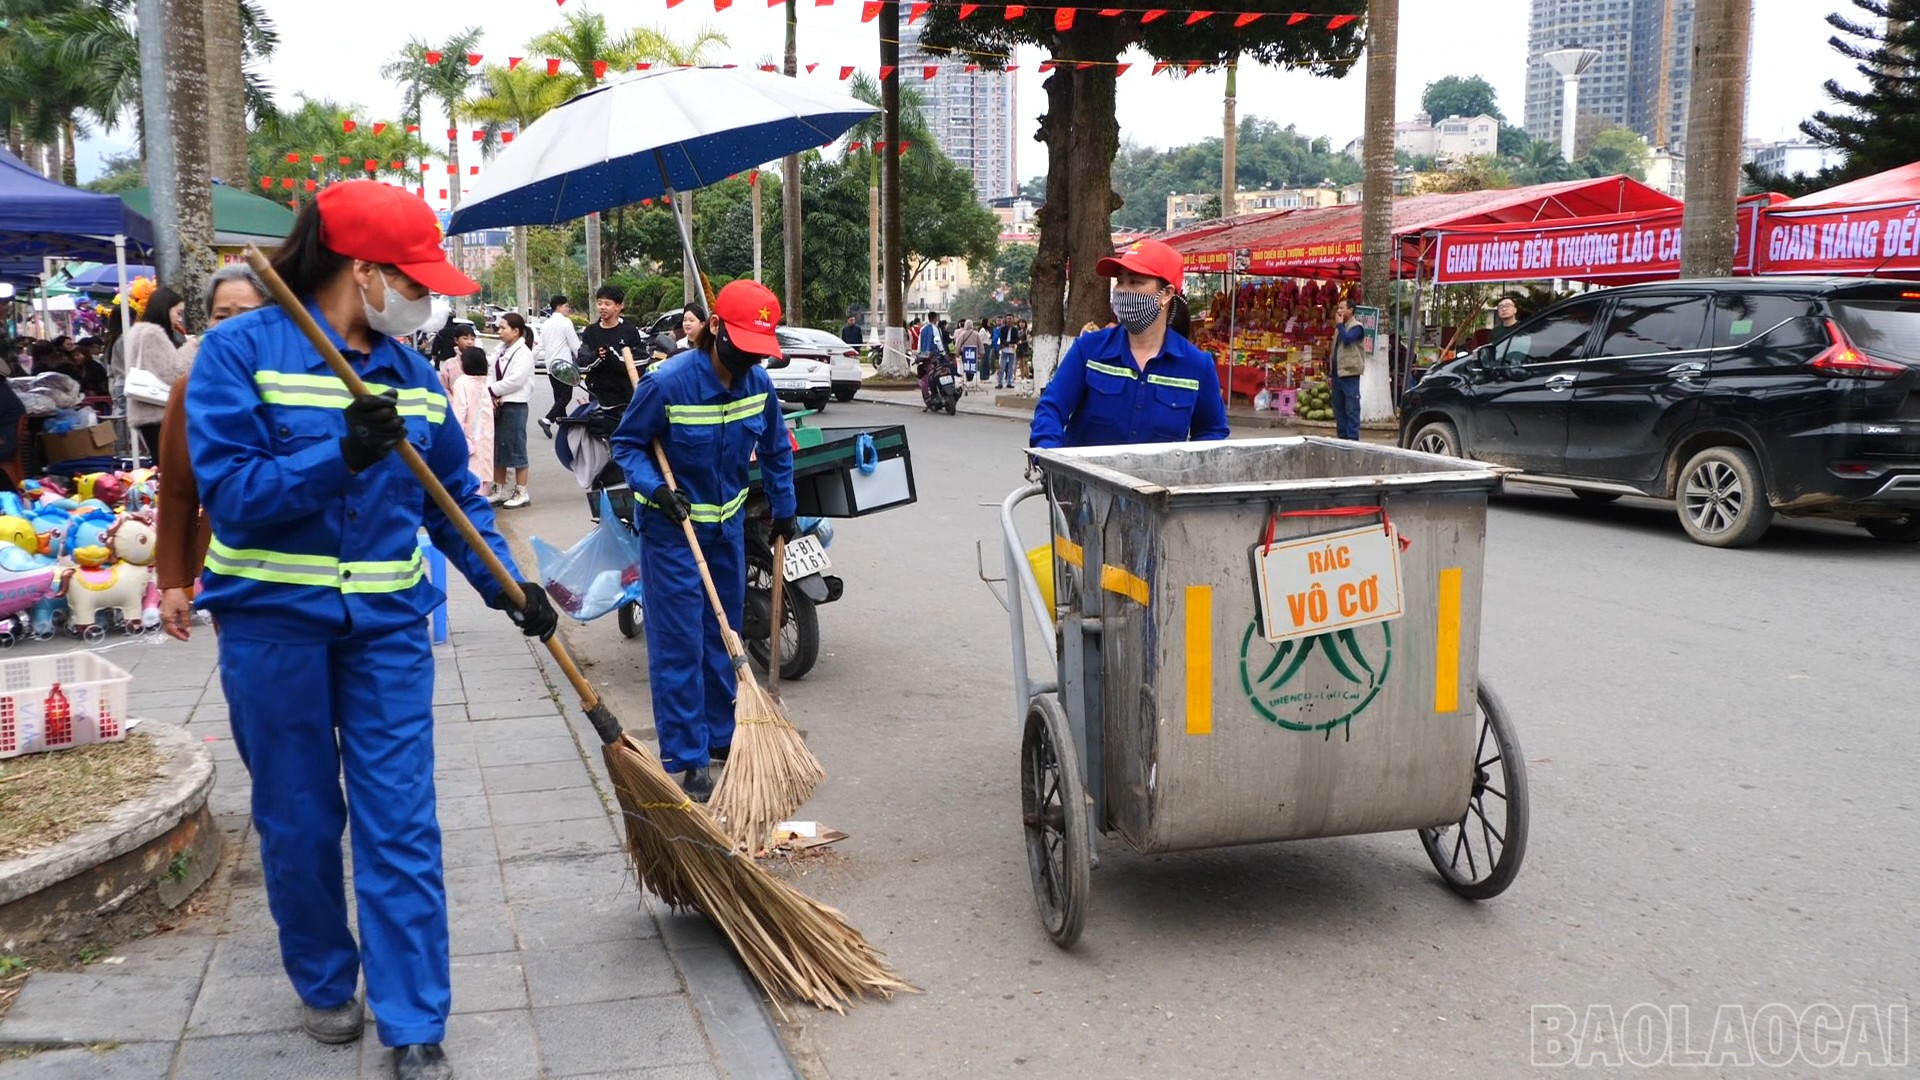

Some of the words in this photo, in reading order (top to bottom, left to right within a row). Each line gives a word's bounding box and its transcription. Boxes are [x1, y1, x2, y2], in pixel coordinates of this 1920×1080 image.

[1446, 243, 1479, 274] GIAN
[1480, 236, 1520, 271] HÀNG
[1556, 231, 1618, 273] THƯỢNG
[1622, 225, 1654, 264] LÀO
[1769, 224, 1816, 262] GIAN
[1819, 215, 1881, 259] HÀNG
[1307, 544, 1351, 575] RÁC
[1286, 582, 1329, 628] VÔ
[1337, 574, 1380, 618] CƠ
